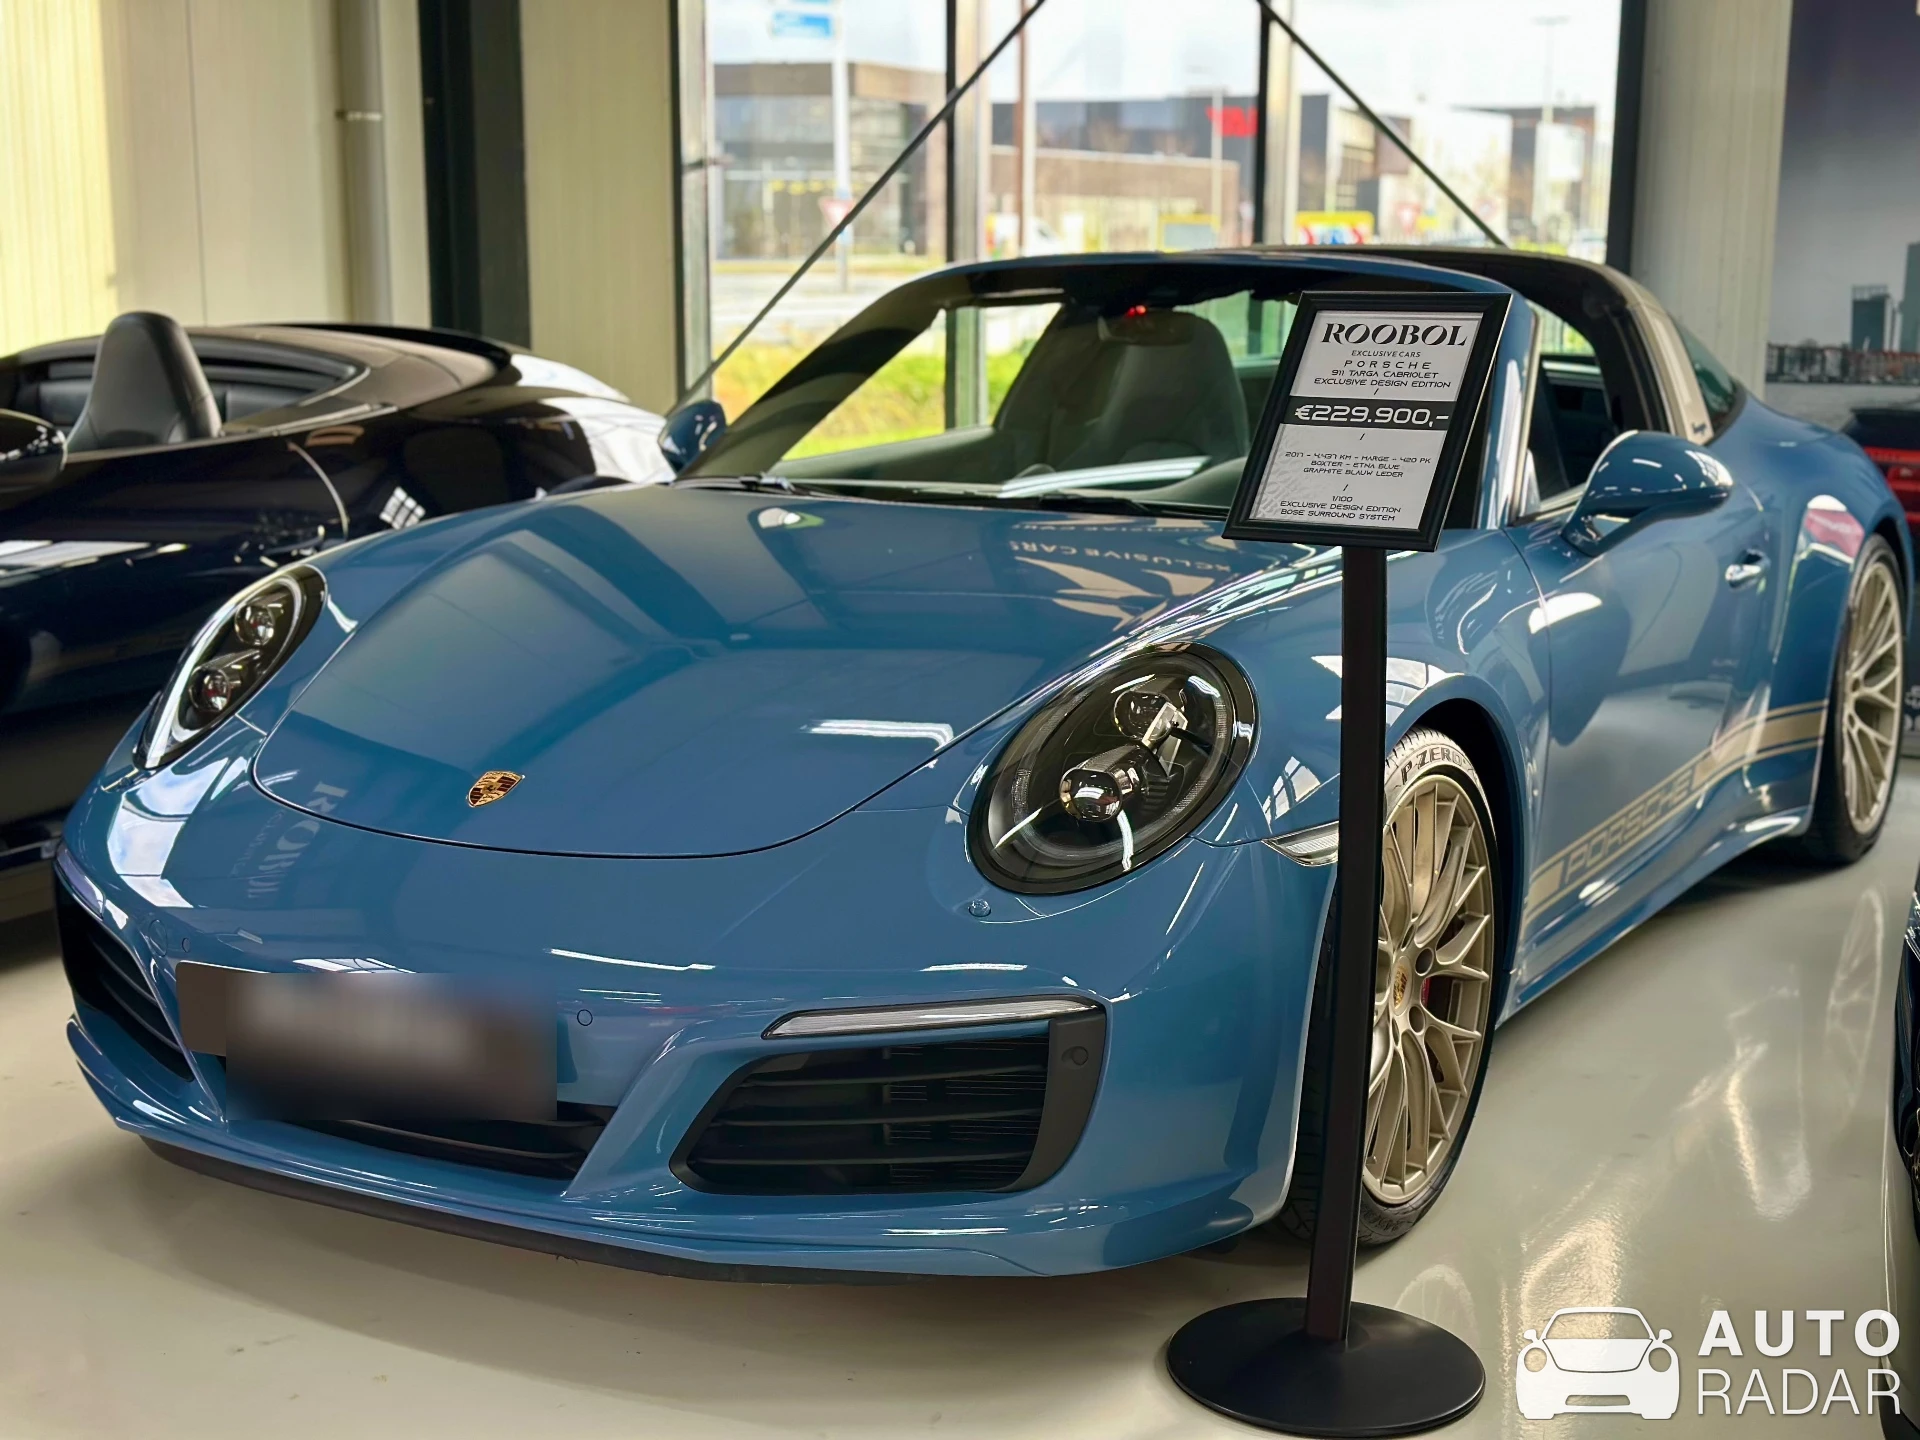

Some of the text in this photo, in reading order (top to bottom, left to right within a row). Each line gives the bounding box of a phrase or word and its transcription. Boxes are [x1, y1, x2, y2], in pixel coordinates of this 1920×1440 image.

[1321, 322, 1468, 346] ROOBOL
[1351, 349, 1421, 358] EXCLUSIVE CARS
[1344, 359, 1432, 370] PORSCHE
[1331, 369, 1439, 379] 911 TARGA CABRIOLET
[1314, 377, 1451, 389] EXCLUSIVE DESIGN EDITION
[1294, 403, 1449, 428] €229.900,-
[1339, 453, 1352, 461] KM
[1303, 467, 1342, 475] GRAPHITE
[1375, 470, 1404, 478] LEDER
[1280, 500, 1402, 513] EXCLUSIVE DESIGN EDITION
[1280, 508, 1396, 521] BOSE SURROUND SYSTEM
[1084, 546, 1234, 574] XCLUSIVE
[1400, 747, 1463, 785] P ZERO
[1564, 769, 1694, 886] PORSCHE
